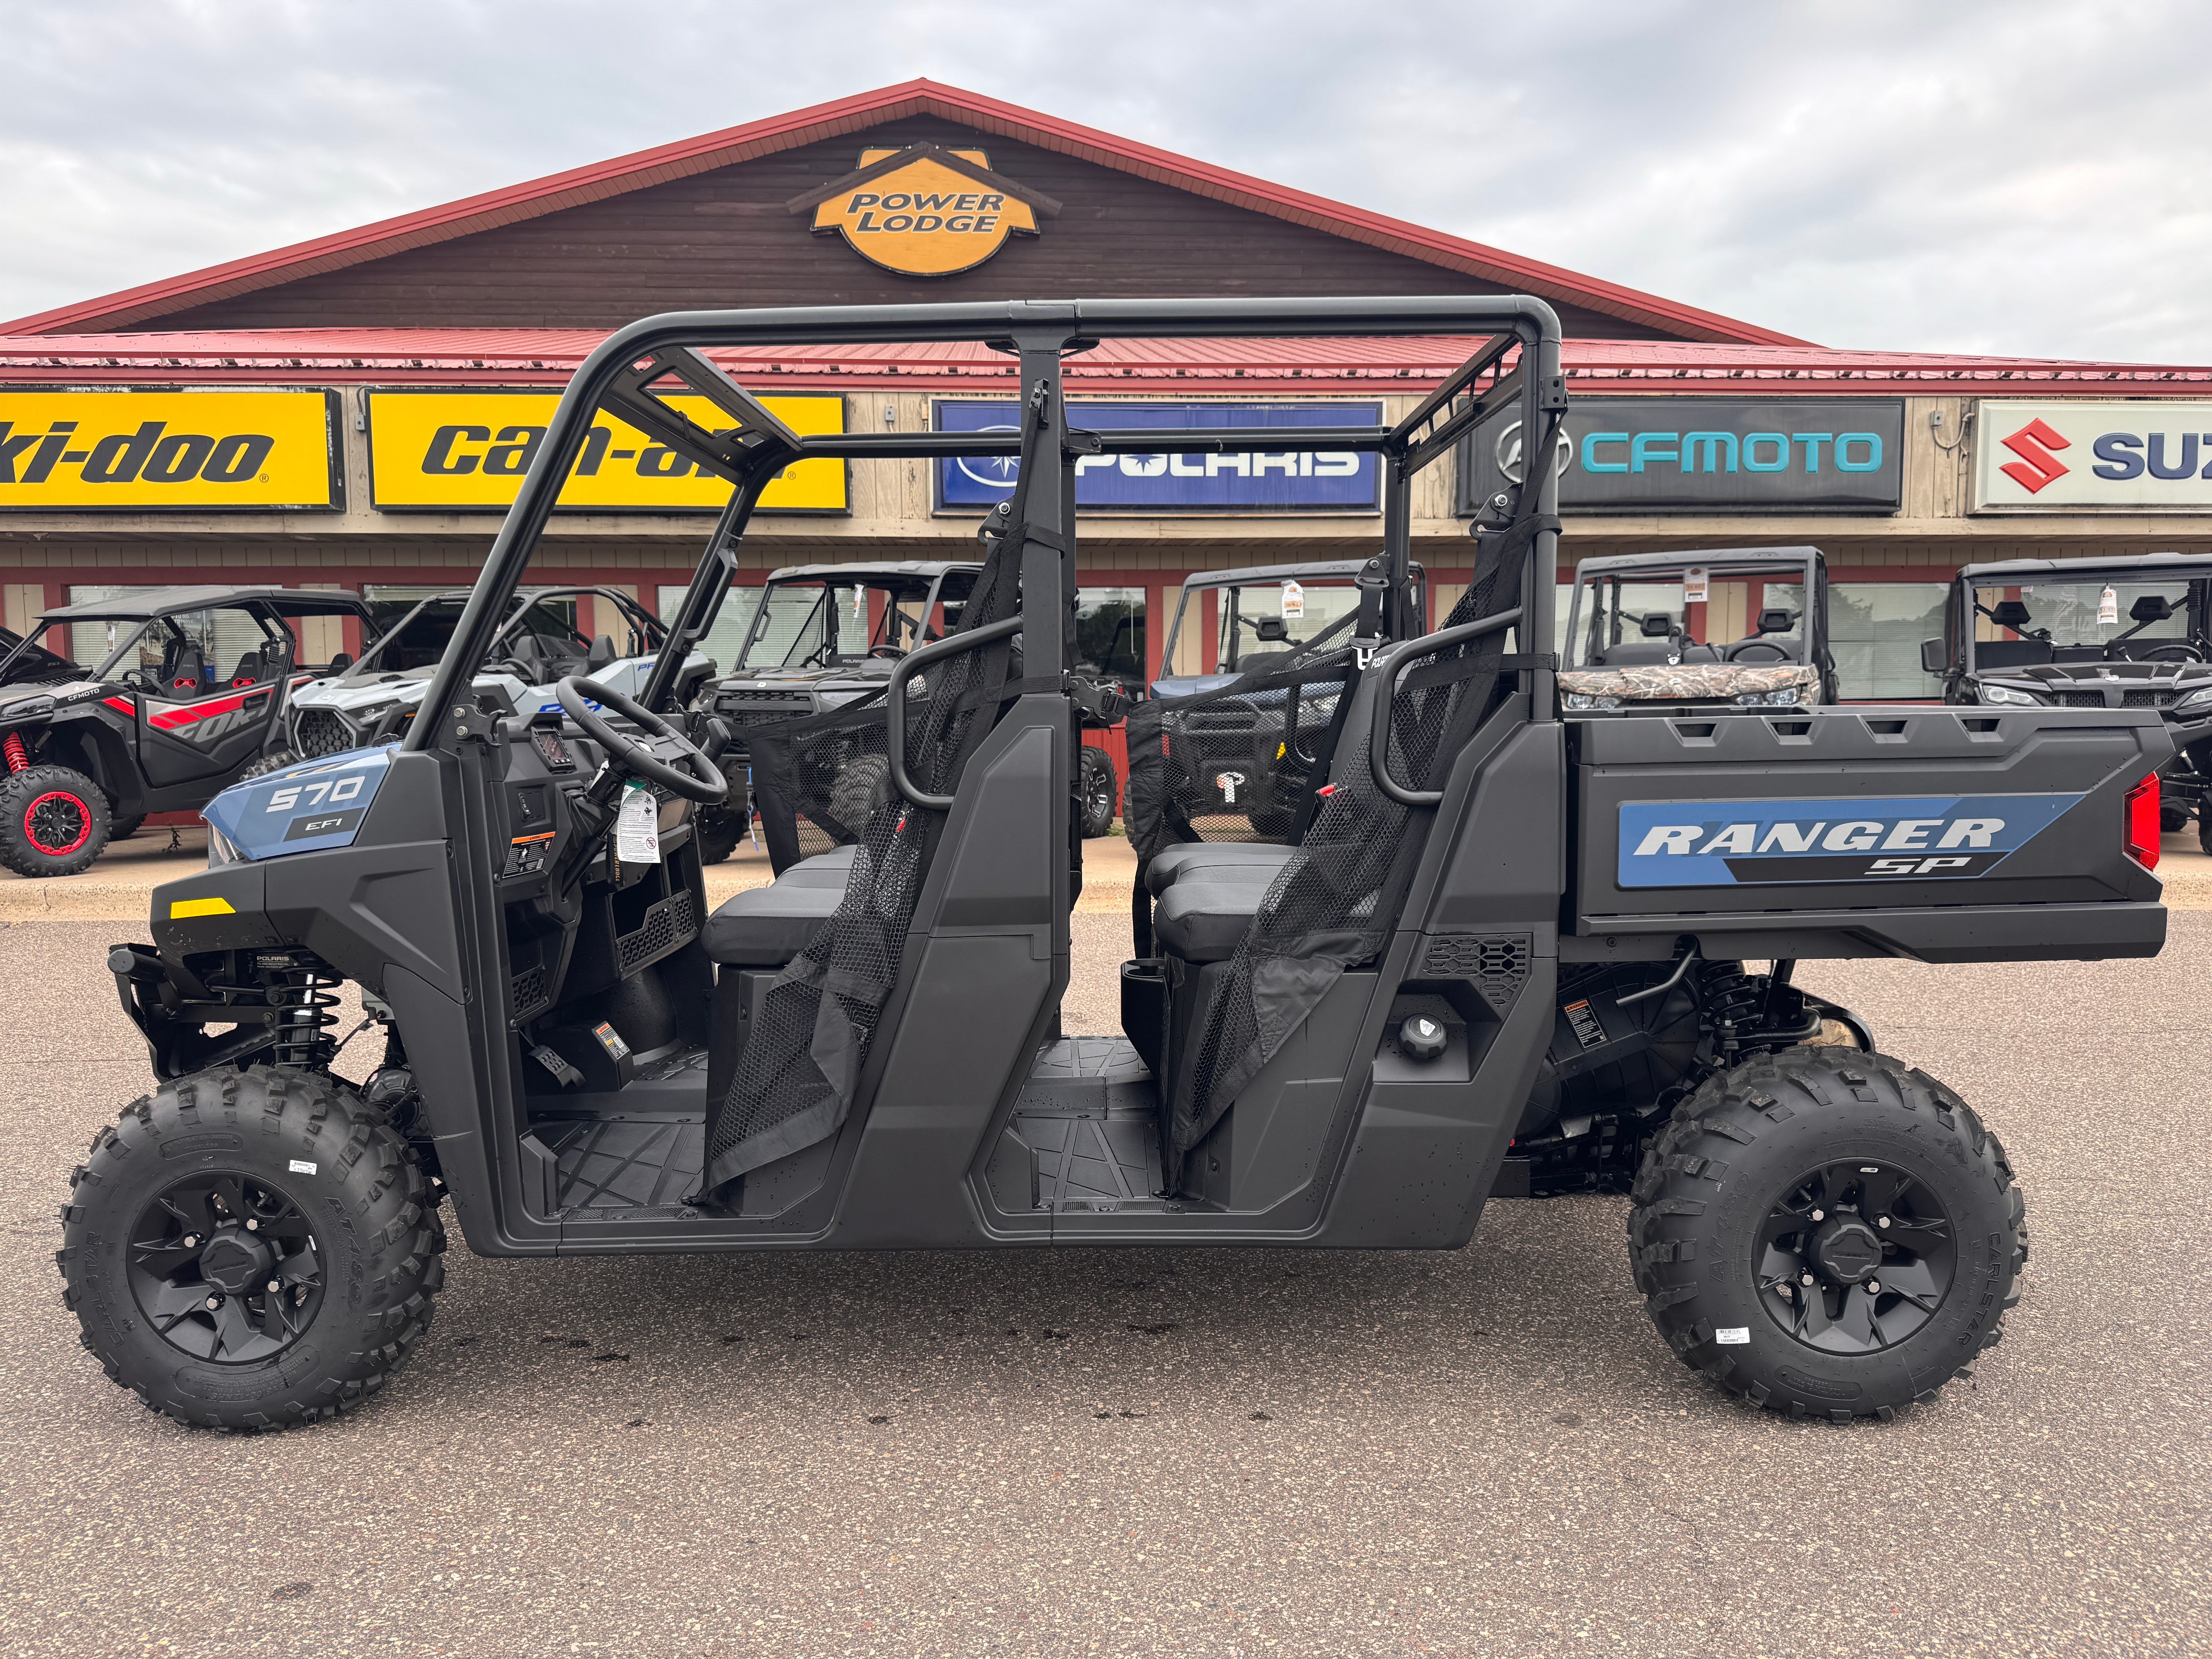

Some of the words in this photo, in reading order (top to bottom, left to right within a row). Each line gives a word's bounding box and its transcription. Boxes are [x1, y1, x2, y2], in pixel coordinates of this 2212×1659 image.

[847, 194, 1004, 214] POWER
[856, 212, 998, 232] LODGE
[421, 425, 783, 479] can-a
[1075, 452, 1360, 477] POLARIS
[1581, 431, 1883, 473] CFMOTO
[2092, 433, 2212, 480] SU
[68, 688, 100, 701] CFMOTO
[266, 776, 366, 813] 570
[305, 818, 342, 831] EFI
[1633, 818, 2005, 855] RANGER
[1863, 857, 1972, 874] SP
[1569, 1001, 1587, 1010] WARNING
[84, 1231, 124, 1347] CARLSTAR
[1956, 1232, 2001, 1346] CARLSTAR
